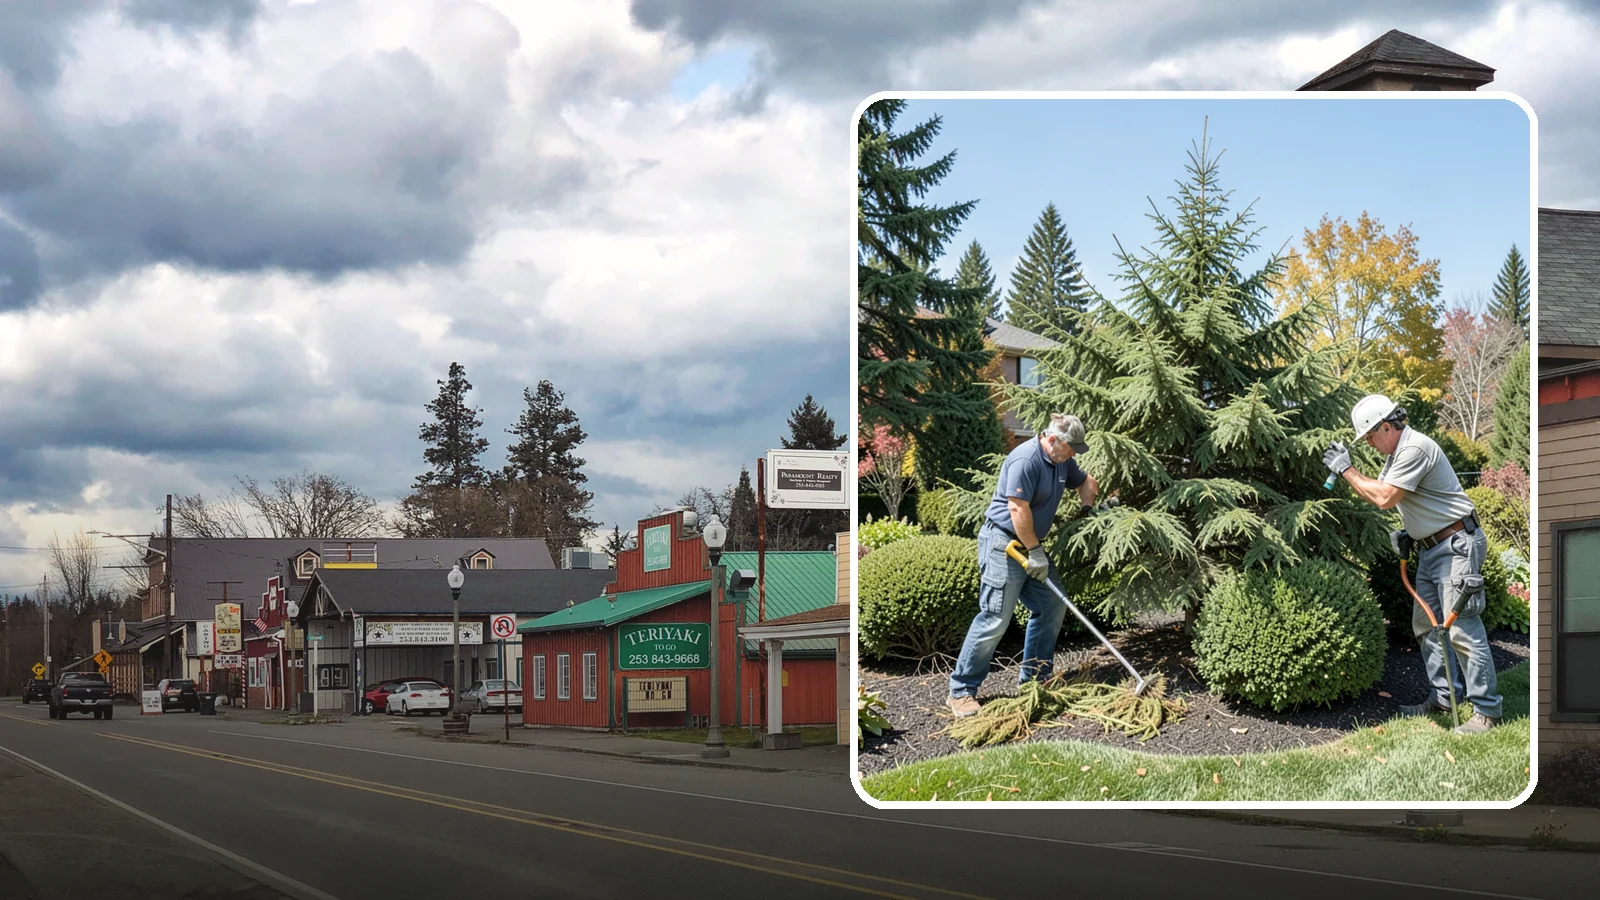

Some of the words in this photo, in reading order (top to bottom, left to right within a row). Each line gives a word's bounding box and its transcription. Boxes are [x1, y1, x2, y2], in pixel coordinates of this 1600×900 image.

[624, 627, 702, 646] TERIYAKI
[654, 643, 665, 651] TO
[665, 643, 677, 651] GO
[628, 654, 649, 664] 253
[651, 653, 700, 664] 843-9668
[639, 681, 673, 691] TERIYAKI
